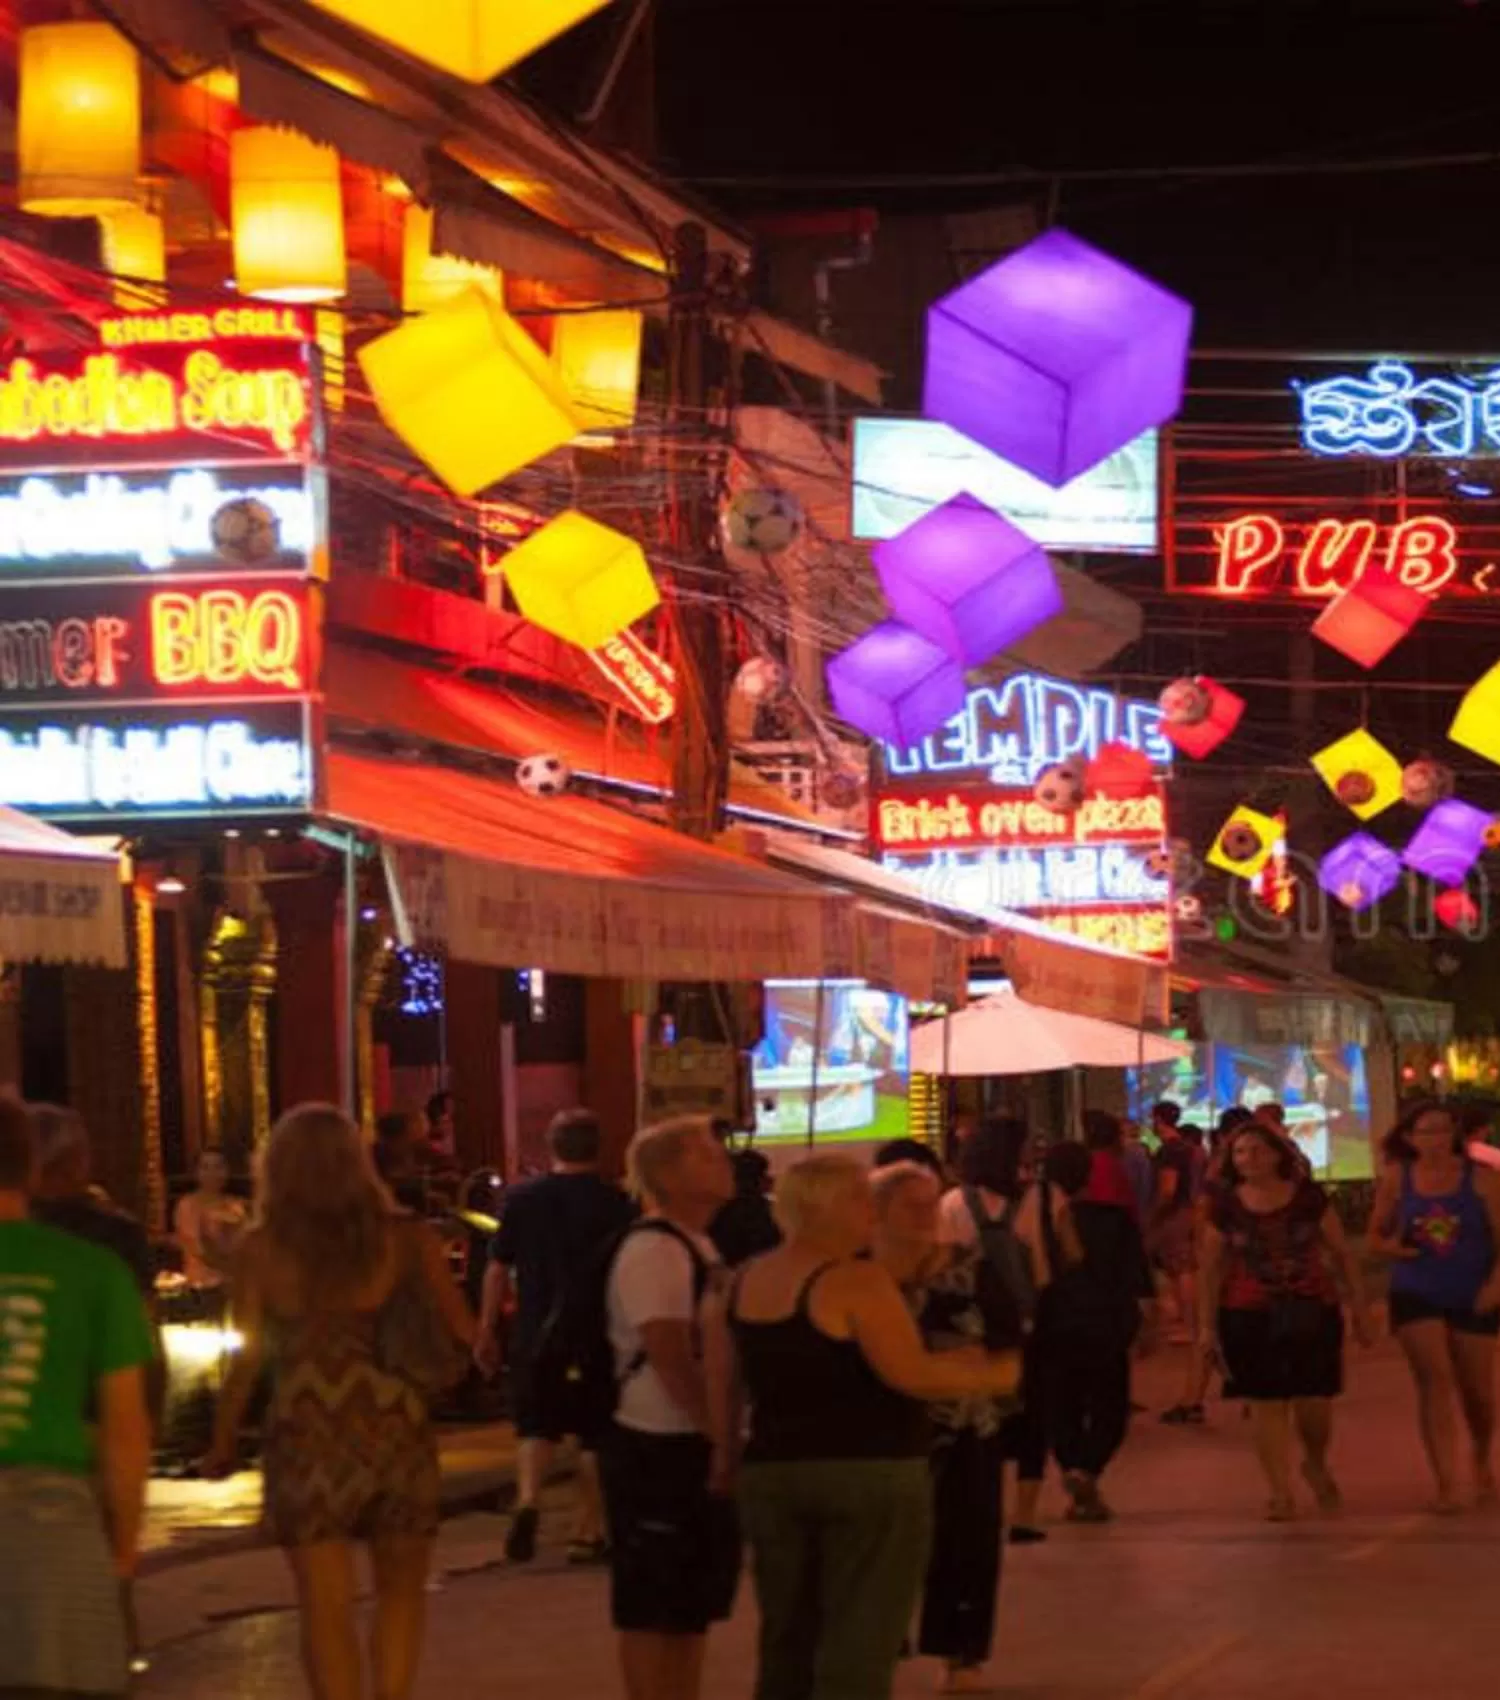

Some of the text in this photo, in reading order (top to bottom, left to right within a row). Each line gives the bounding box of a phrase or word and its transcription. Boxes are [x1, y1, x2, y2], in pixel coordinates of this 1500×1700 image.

[182, 350, 304, 450] Soup
[1216, 515, 1457, 594] PUB
[151, 588, 301, 688] BBQ
[880, 796, 972, 842] Brick
[1074, 791, 1163, 848] pizza
